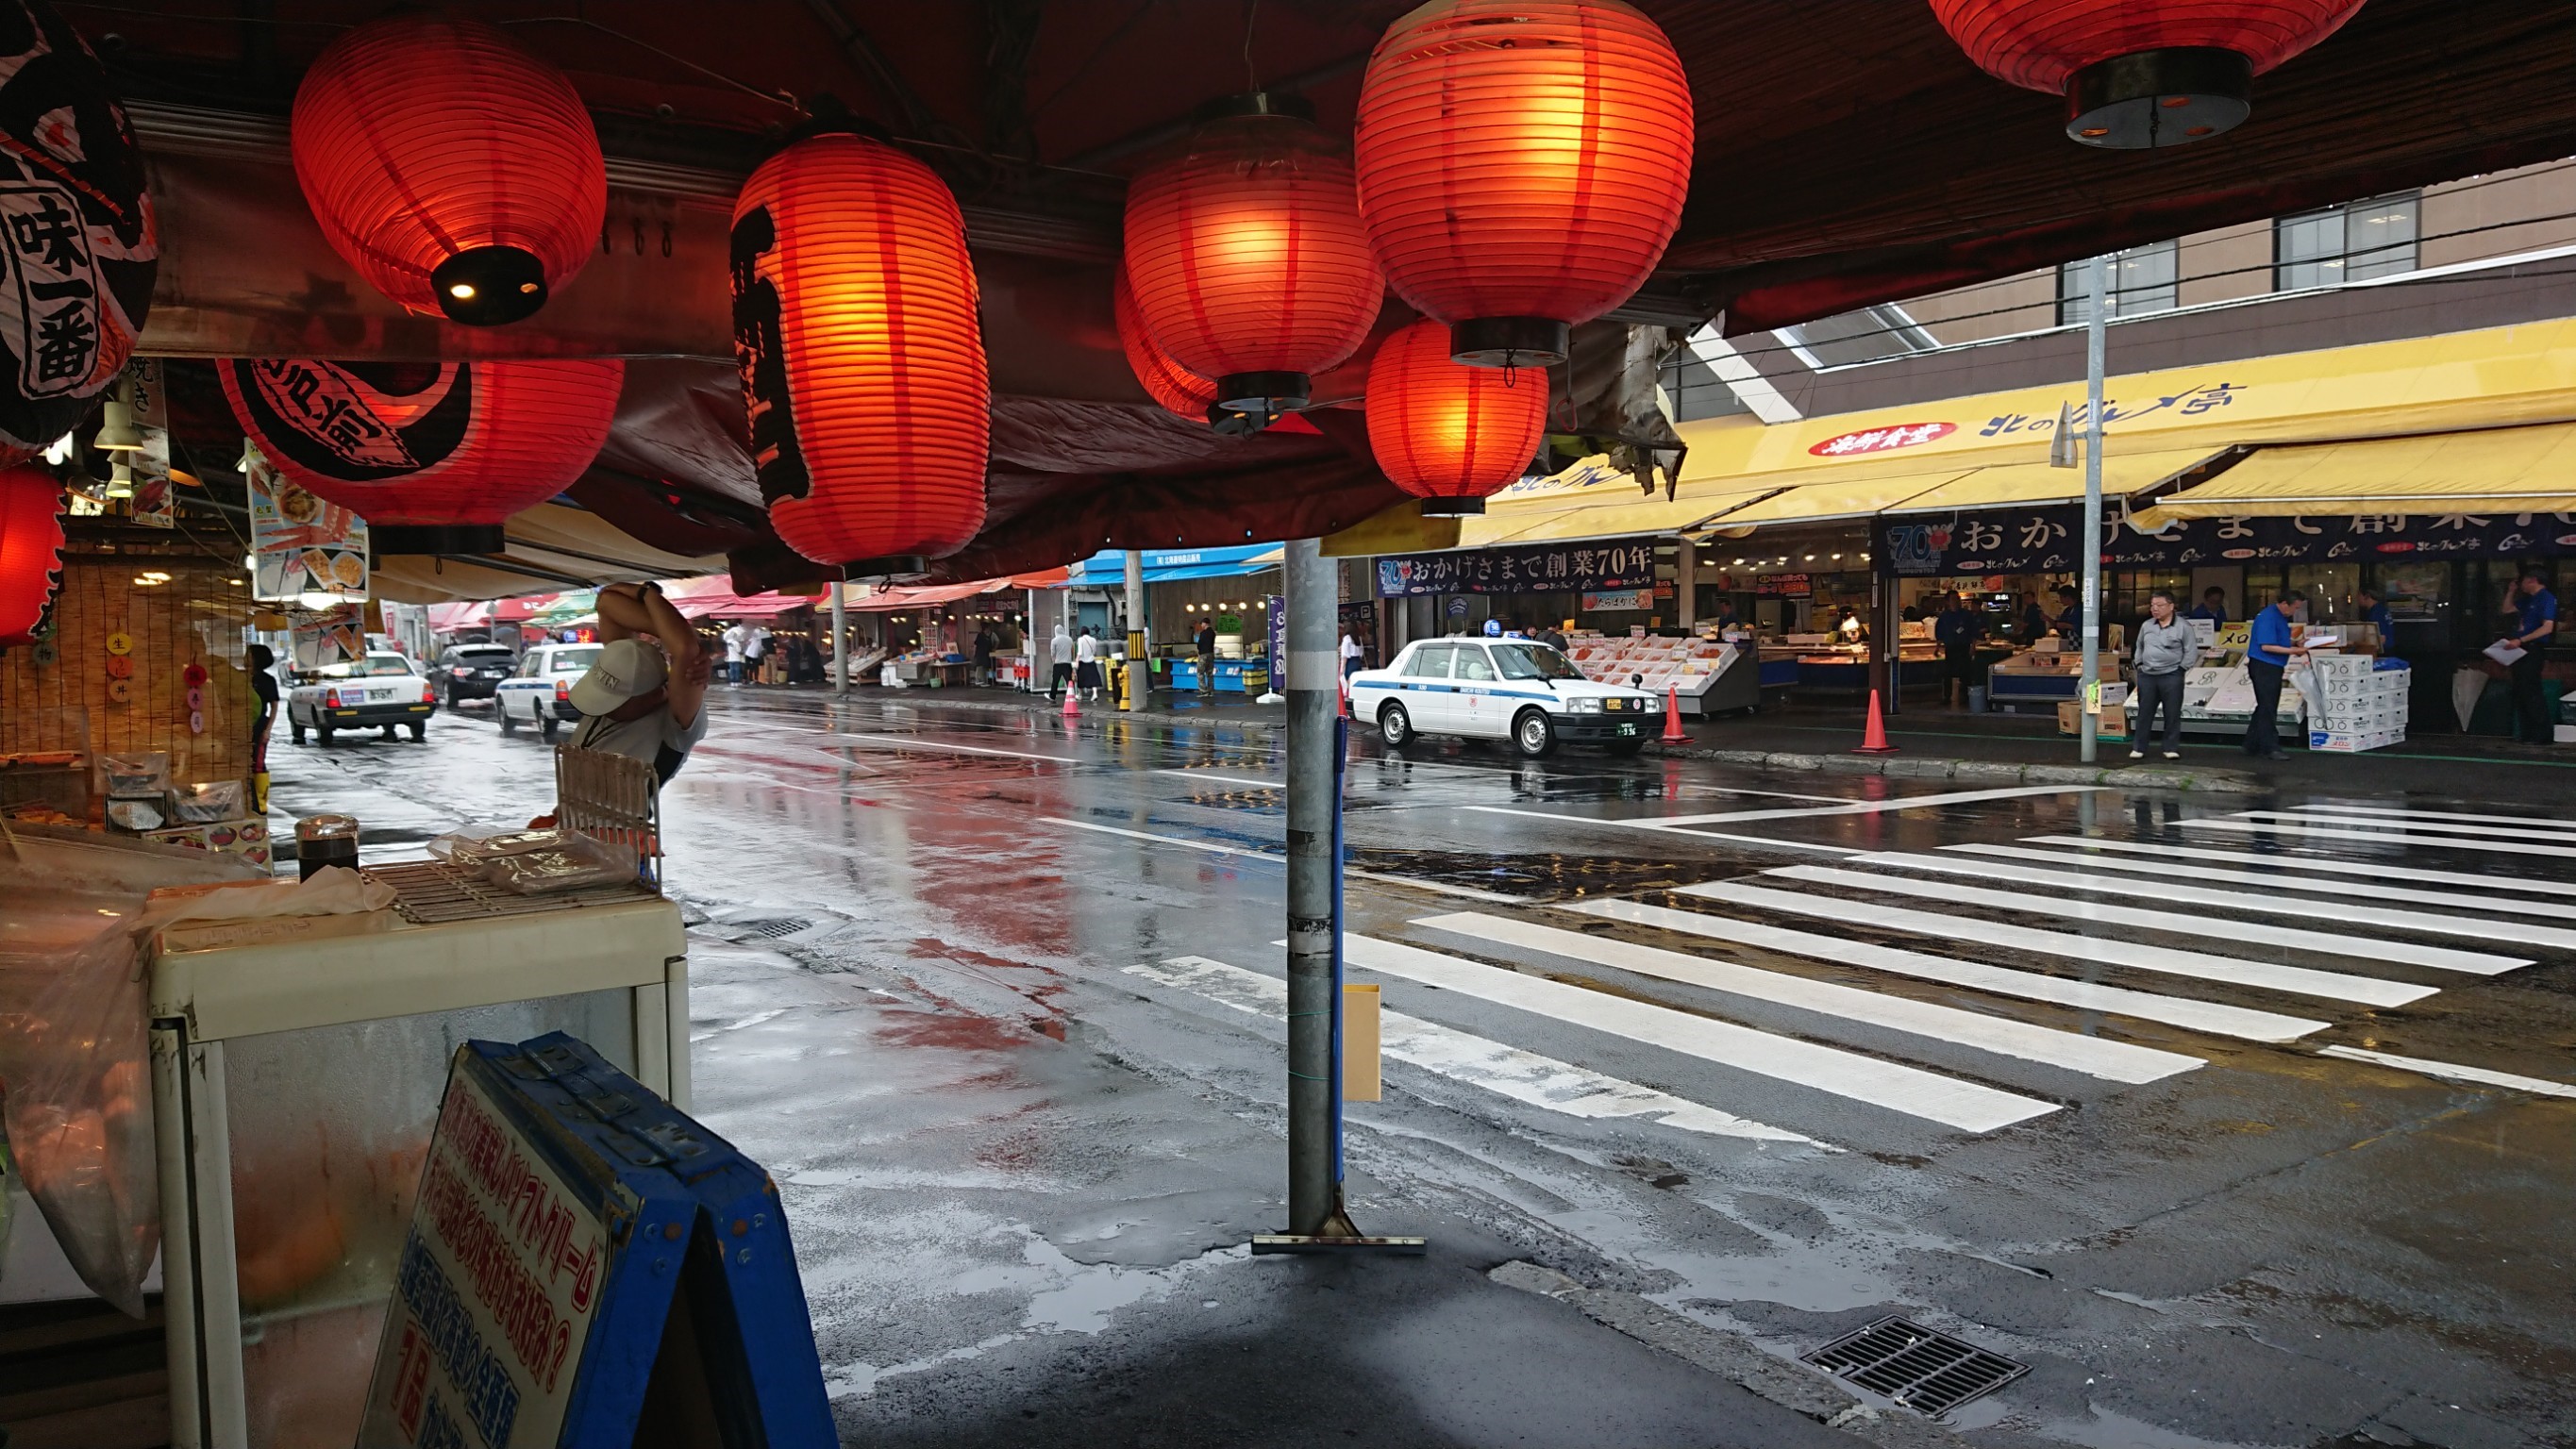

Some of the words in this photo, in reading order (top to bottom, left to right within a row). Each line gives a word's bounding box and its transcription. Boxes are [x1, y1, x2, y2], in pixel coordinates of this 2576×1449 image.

[8, 194, 95, 383] 味一番
[1413, 546, 1652, 582] おかげさまで創業70年
